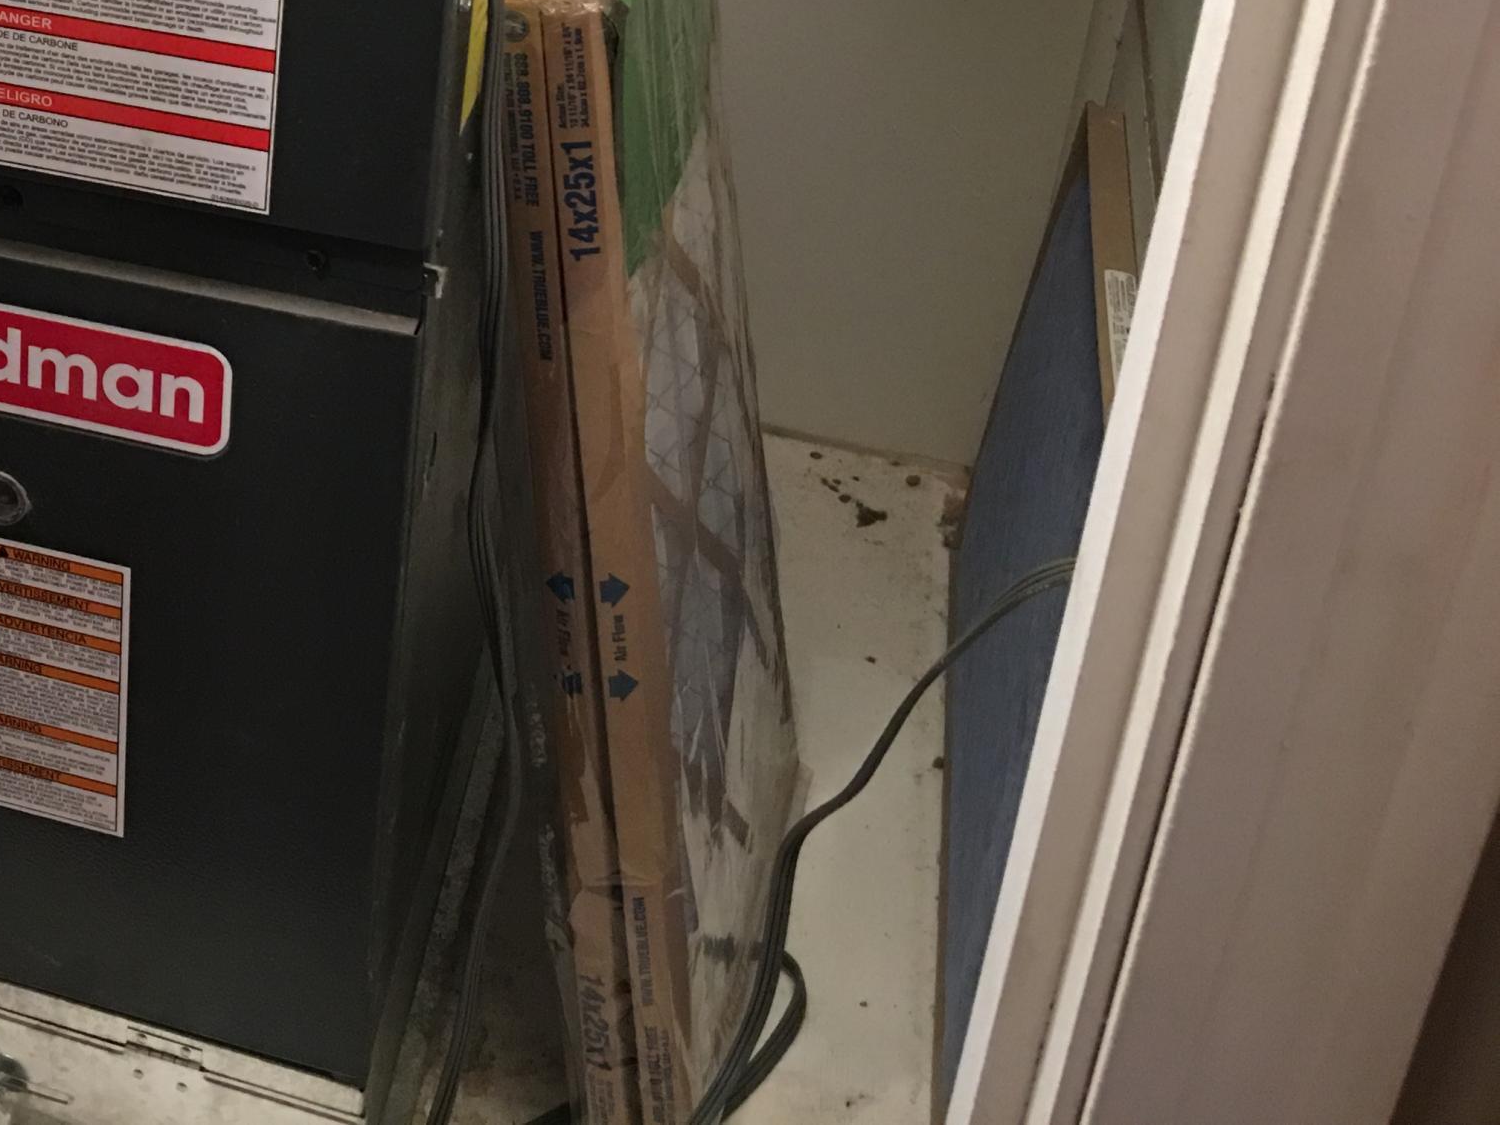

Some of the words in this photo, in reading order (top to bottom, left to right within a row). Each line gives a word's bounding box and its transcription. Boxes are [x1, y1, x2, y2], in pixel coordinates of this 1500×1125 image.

[13, 32, 24, 41] DE
[29, 35, 78, 50] CARBONE
[2, 108, 15, 118] DE
[18, 111, 68, 127] CARBONO
[522, 143, 537, 172] TOLL
[524, 176, 539, 207] FREE
[560, 140, 601, 262] 14x25x1
[530, 230, 553, 361] WWW.TRUEBLUE.COM
[12, 549, 70, 572] WARNING
